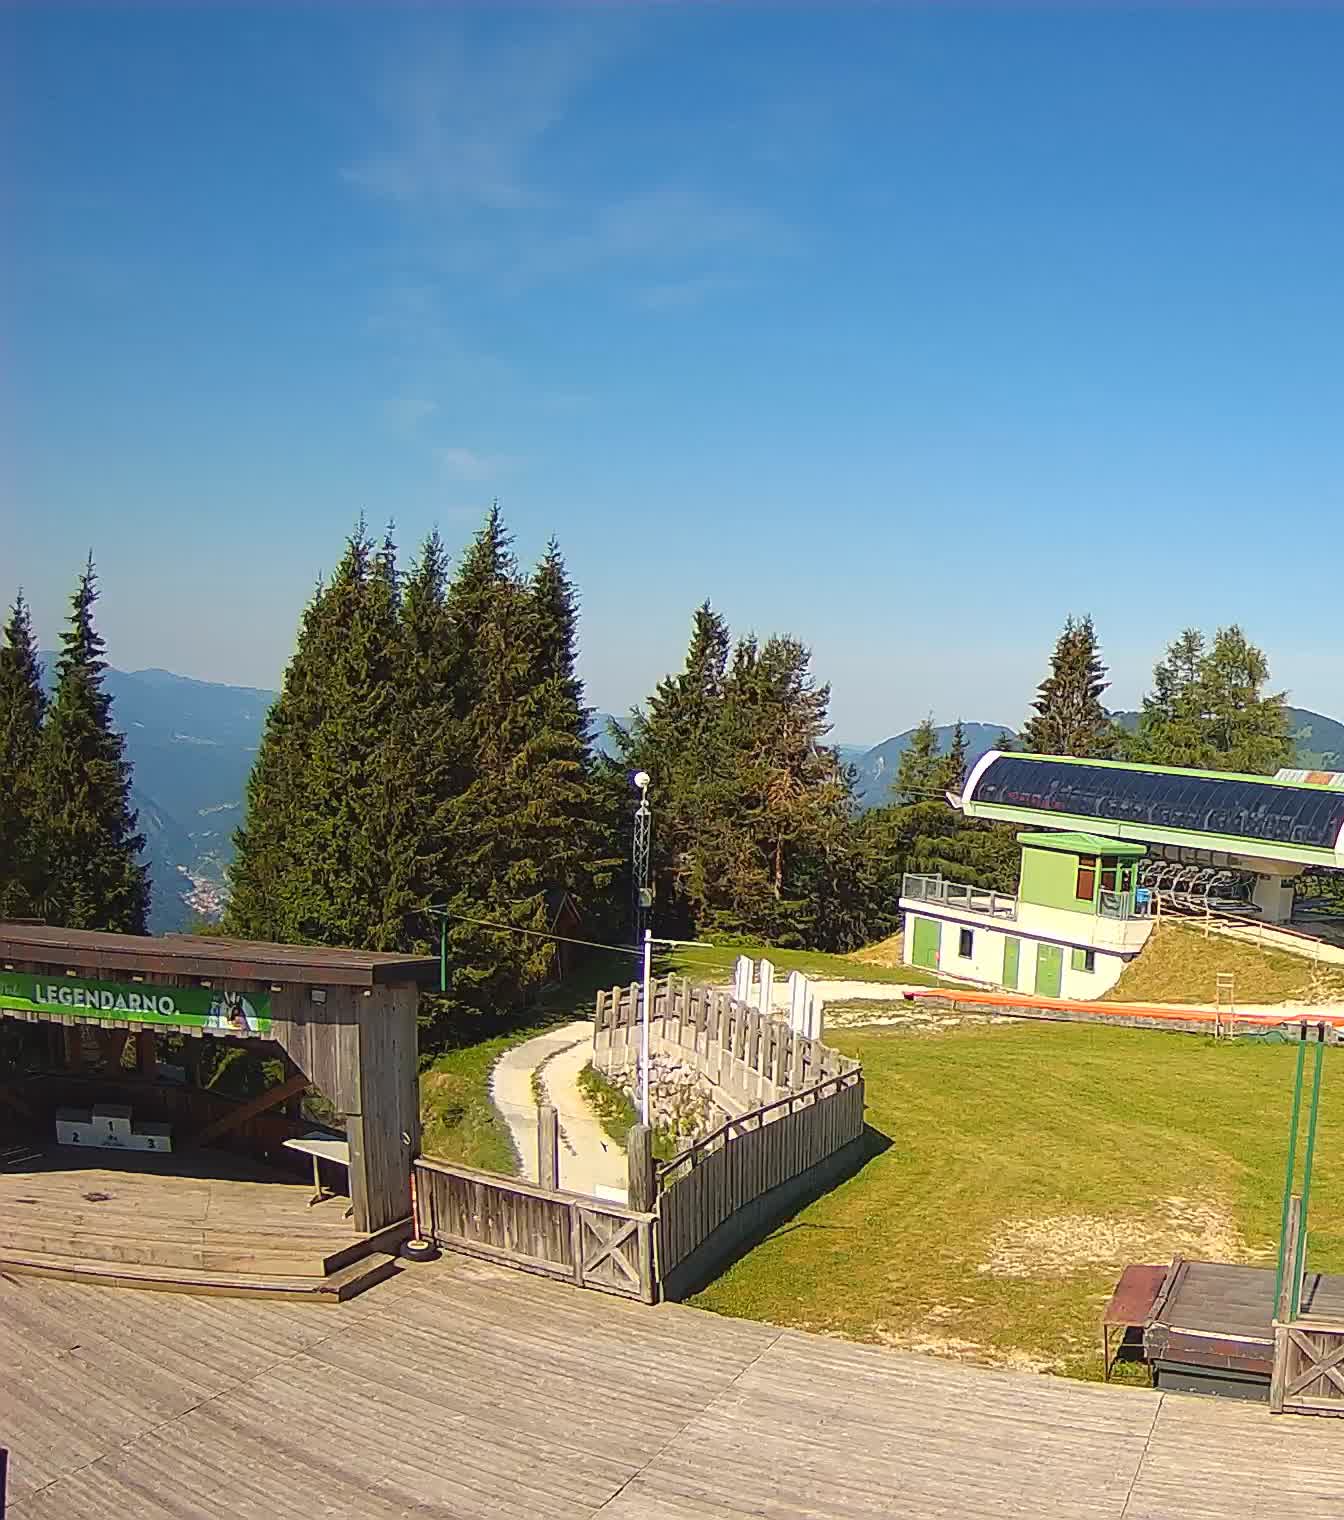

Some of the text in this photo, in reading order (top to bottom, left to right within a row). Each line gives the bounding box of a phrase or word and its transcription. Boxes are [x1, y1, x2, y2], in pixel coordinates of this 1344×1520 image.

[107, 1120, 114, 1132] 1
[72, 1131, 80, 1143] 2
[147, 1138, 156, 1149] 3
